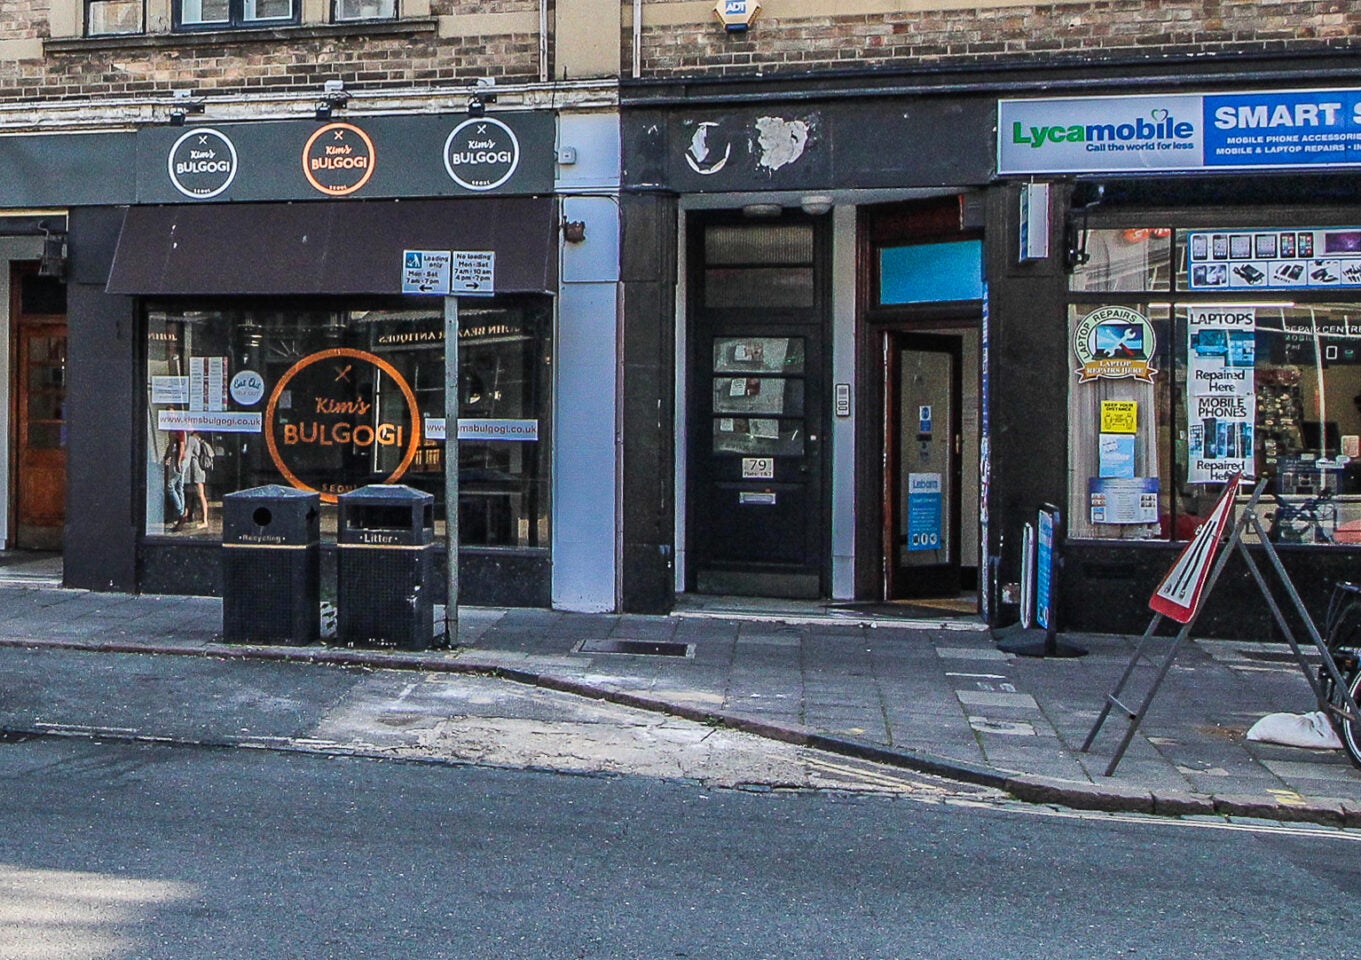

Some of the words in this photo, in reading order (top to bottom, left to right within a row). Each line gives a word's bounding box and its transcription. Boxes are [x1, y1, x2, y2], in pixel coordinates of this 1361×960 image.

[726, 1, 747, 11] ADT
[1214, 102, 1342, 129] SMART
[1013, 111, 1194, 148] Lycamobile
[1226, 136, 1264, 144] MOBILE
[1266, 135, 1299, 143] PHONE
[1086, 143, 1106, 152] Call
[1107, 143, 1125, 151] the
[1126, 142, 1155, 151] world
[1157, 141, 1172, 150] for
[1173, 141, 1194, 150] less
[1215, 147, 1253, 155] MOBILE
[1305, 144, 1345, 152] REPAIRS
[311, 156, 368, 171] BULGOGI
[452, 151, 511, 165] BULGOGI
[176, 161, 230, 174] BULGOGI
[1190, 313, 1253, 325] LAPTOPS
[1078, 322, 1091, 360] LAPTOP
[1092, 310, 1138, 323] REPAIRS
[1195, 369, 1246, 382] Repaired
[1209, 382, 1236, 392] Here
[315, 395, 371, 415] Kim's
[1198, 398, 1245, 408] MOBILE
[1198, 407, 1247, 417] PHONES
[283, 422, 403, 447] BULGOGI
[749, 460, 767, 471] 79
[1196, 460, 1246, 472] Repaired
[363, 533, 393, 543] Litter
